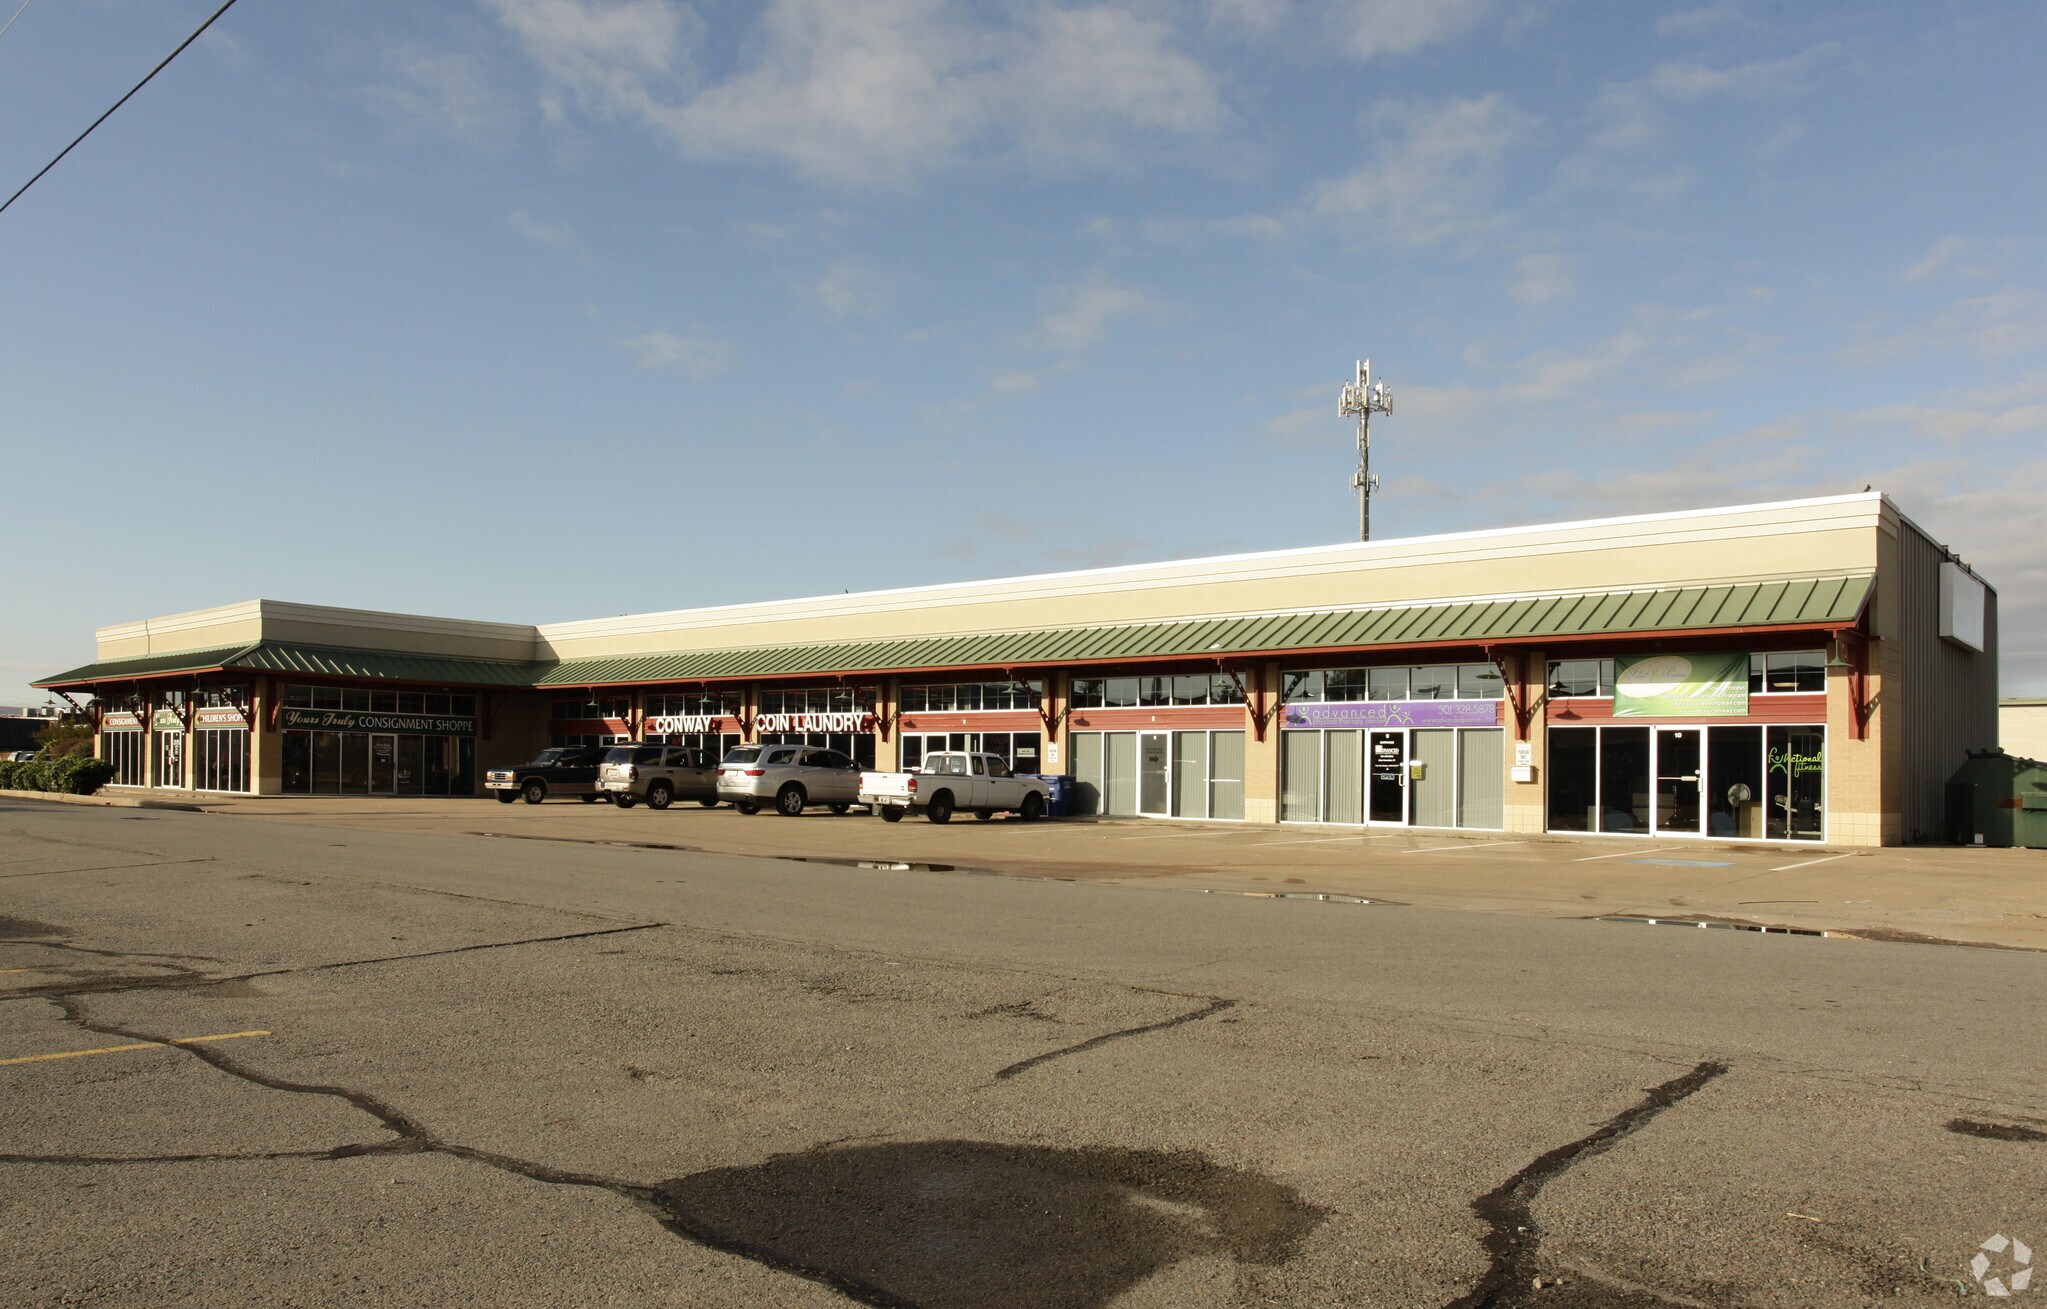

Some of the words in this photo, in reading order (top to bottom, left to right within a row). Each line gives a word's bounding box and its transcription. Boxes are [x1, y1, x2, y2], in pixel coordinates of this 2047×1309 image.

[1312, 704, 1387, 718] advanced
[285, 711, 319, 726] Yours
[322, 712, 356, 728] Truly
[358, 716, 434, 731] CONSIGNMENT
[436, 719, 473, 732] SHOPPE
[656, 716, 713, 733] CONWAY
[756, 714, 790, 732] COIN
[795, 713, 864, 732] LAUNDRY
[1312, 718, 1337, 726] physical
[1338, 717, 1364, 725] therapy
